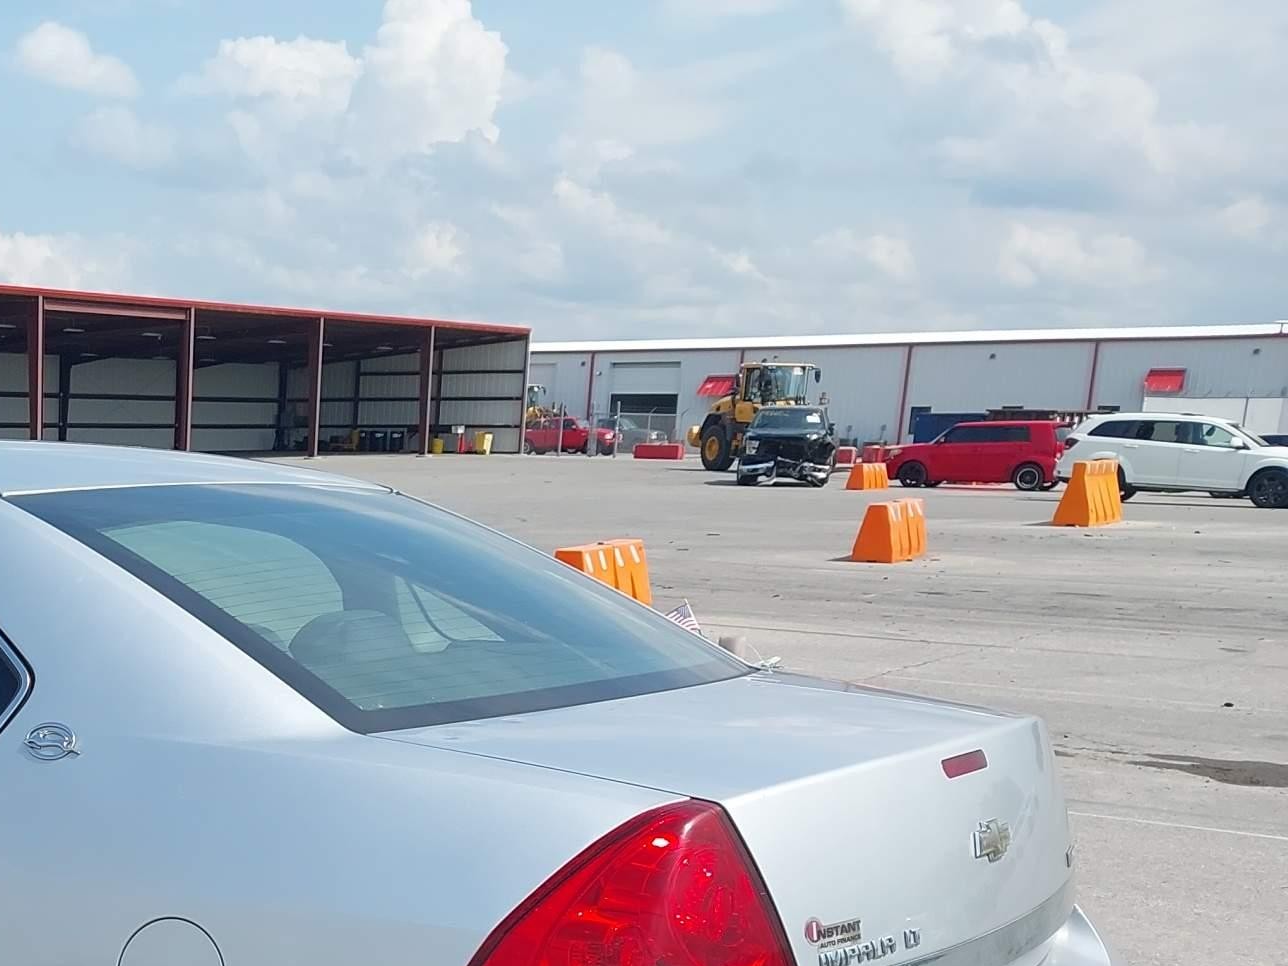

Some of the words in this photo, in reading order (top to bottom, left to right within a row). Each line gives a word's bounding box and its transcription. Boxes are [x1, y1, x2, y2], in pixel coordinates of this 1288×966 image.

[807, 919, 861, 941] INSTANT
[820, 940, 837, 949] AUTO
[837, 933, 862, 945] FINANCE
[904, 928, 921, 950] LT
